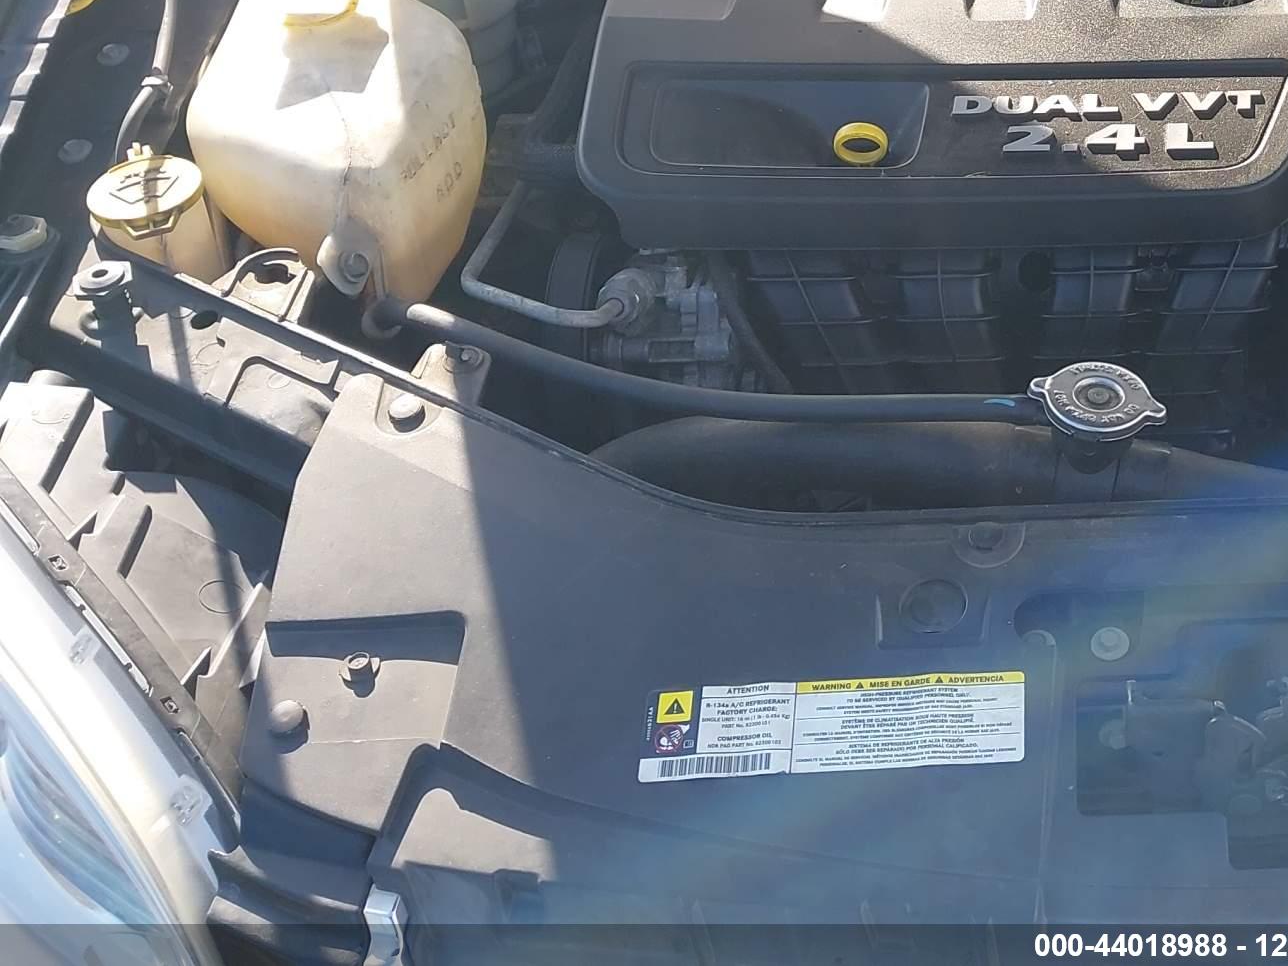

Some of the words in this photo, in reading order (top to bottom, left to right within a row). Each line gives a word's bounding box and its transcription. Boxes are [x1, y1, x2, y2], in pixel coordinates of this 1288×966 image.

[950, 92, 1123, 121] DUAL
[1132, 89, 1266, 120] VVT
[1002, 122, 1219, 161] 2.4L
[726, 684, 770, 695] ATTENTION
[811, 682, 852, 691] WARNING
[869, 681, 889, 689] MISE
[904, 677, 931, 686] GARDE
[731, 701, 745, 709] A/C
[745, 698, 791, 707] REFRIGERANT
[717, 708, 748, 716] FACTORY
[717, 733, 761, 742] COMPRESSOR
